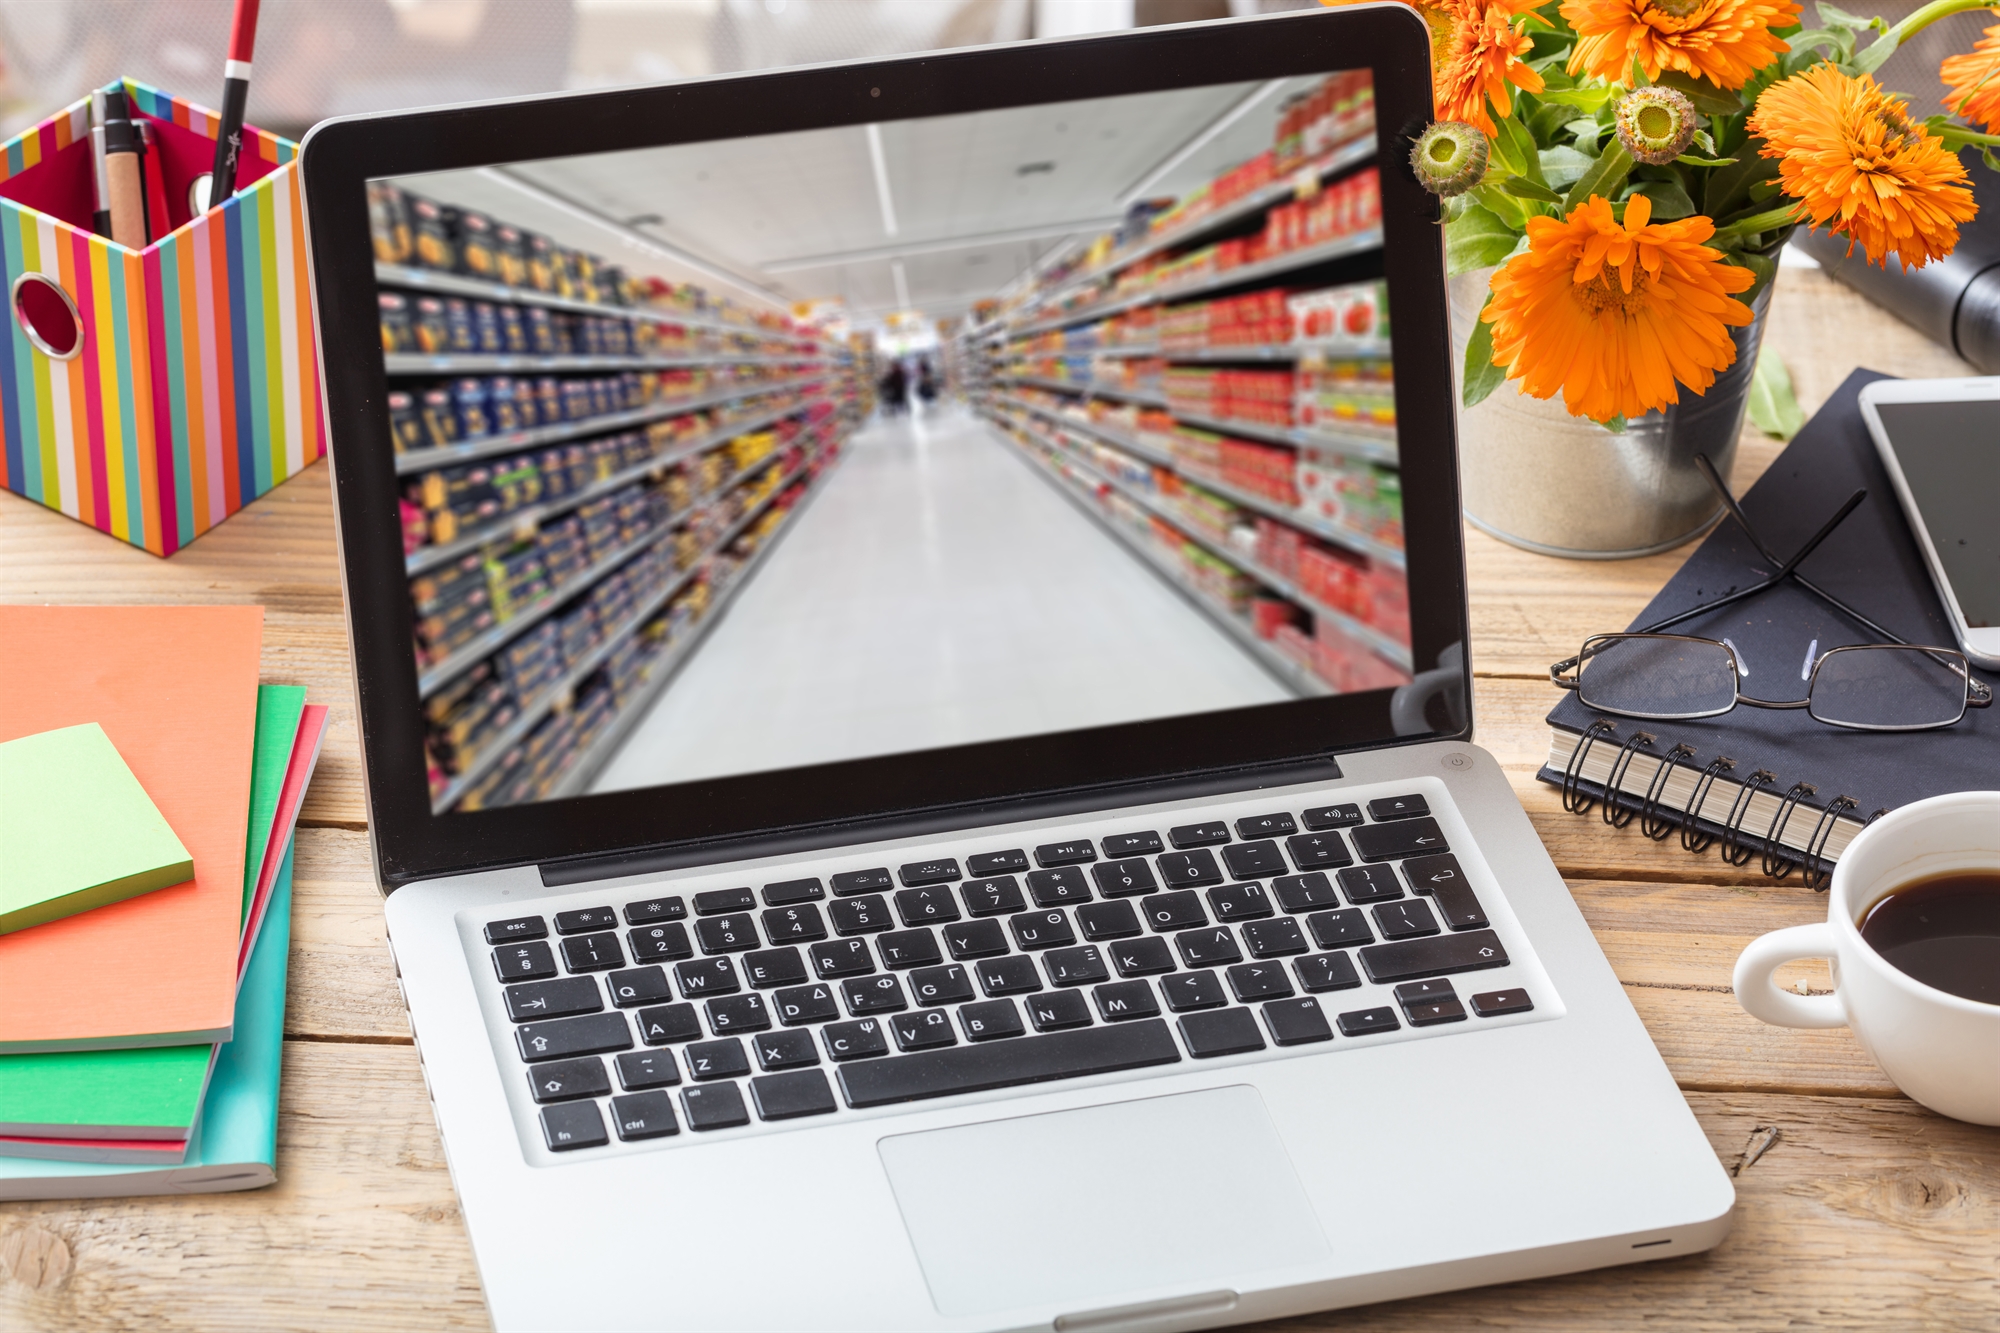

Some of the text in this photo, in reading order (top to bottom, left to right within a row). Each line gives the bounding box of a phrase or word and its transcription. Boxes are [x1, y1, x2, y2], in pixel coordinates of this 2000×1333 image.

[1345, 811, 1359, 820] F12
[1280, 820, 1293, 829] F11
[1212, 829, 1226, 838] F10
[1149, 838, 1159, 847] F9
[1014, 857, 1023, 865] F7
[946, 867, 957, 875] F6
[878, 876, 888, 884] F5
[1122, 876, 1133, 886] 9
[809, 886, 819, 895] F4
[985, 883, 998, 893] &
[1057, 885, 1068, 896] 8
[740, 895, 751, 904] F3
[990, 895, 1000, 905] 7
[670, 904, 681, 913] F2
[850, 900, 867, 911] %
[925, 903, 936, 914] 6
[1220, 902, 1233, 913] P
[603, 914, 612, 923] F1
[786, 909, 798, 921] $
[859, 913, 869, 923] 5
[506, 922, 526, 931] esc
[720, 919, 731, 930] #
[791, 922, 803, 932] 4
[650, 928, 664, 938] @
[724, 932, 736, 943] 3
[1022, 929, 1038, 940] U
[656, 941, 668, 952] 2
[955, 938, 968, 949] Y
[888, 947, 899, 959] T
[1188, 948, 1202, 959] L
[821, 958, 836, 969] R
[1122, 956, 1138, 968] K
[1318, 957, 1328, 968] ?
[754, 967, 766, 979] E
[1058, 966, 1067, 978] J
[686, 975, 705, 988] W
[988, 974, 1005, 987] H
[619, 986, 637, 998] Q
[921, 984, 937, 996] G
[853, 994, 864, 1006] F
[1108, 999, 1128, 1012] M
[1301, 1000, 1314, 1008] alt
[784, 1004, 800, 1016] D
[1038, 1009, 1056, 1022] N
[716, 1013, 730, 1026] S
[650, 1023, 665, 1035] A
[970, 1019, 985, 1032] B
[902, 1029, 916, 1041] V
[834, 1039, 850, 1051] C
[765, 1048, 782, 1061] X
[696, 1058, 712, 1071] Z
[687, 1089, 701, 1097] alt
[625, 1119, 645, 1130] ctrl
[557, 1131, 572, 1141] fn
